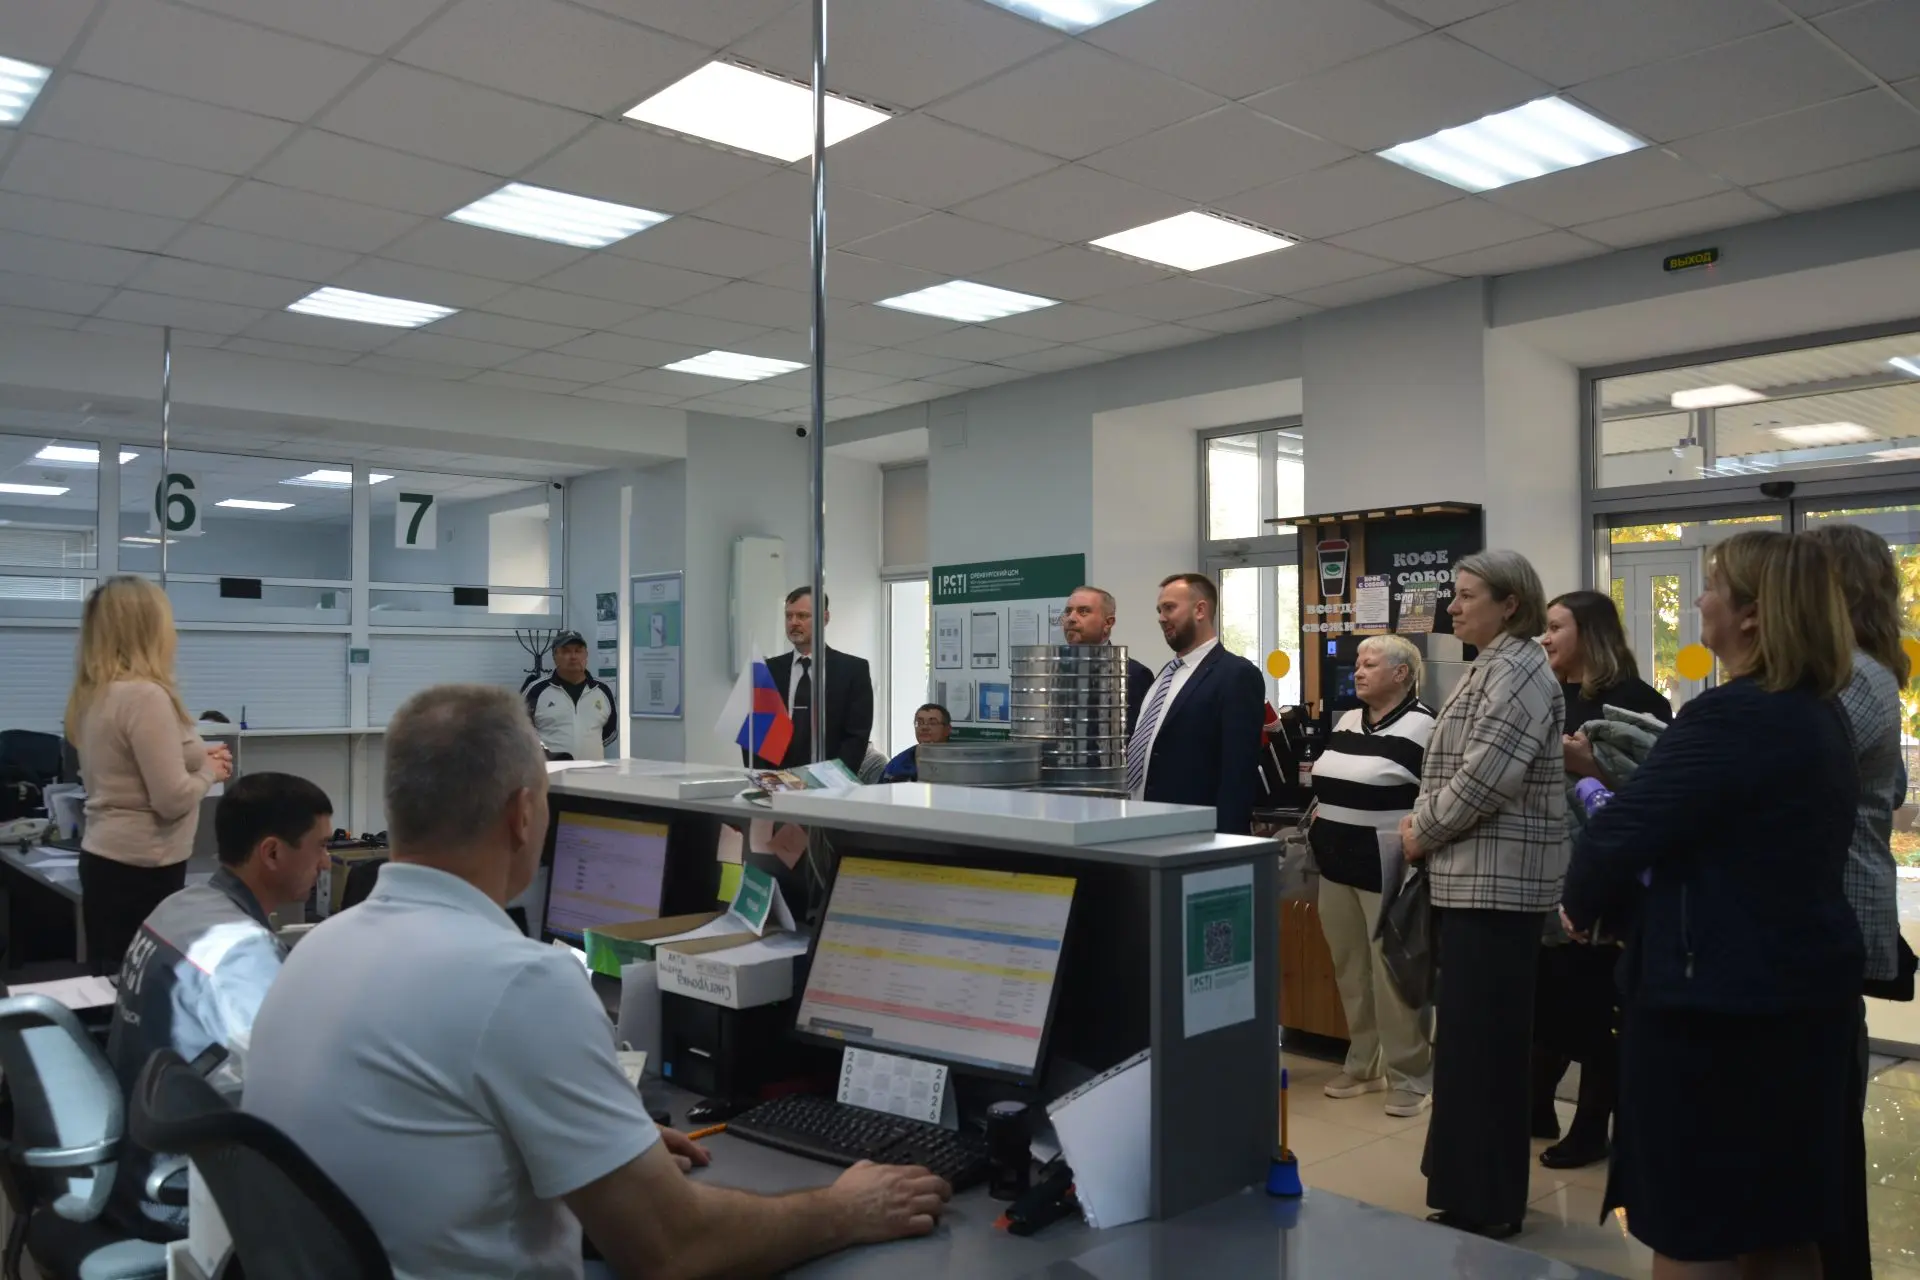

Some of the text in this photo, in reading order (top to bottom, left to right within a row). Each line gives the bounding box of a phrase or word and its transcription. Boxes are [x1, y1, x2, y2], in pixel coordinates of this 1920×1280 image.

[1670, 252, 1712, 268] ВЫХОД
[155, 473, 196, 531] 6
[400, 492, 433, 545] 7
[1393, 550, 1448, 567] КОФЕ
